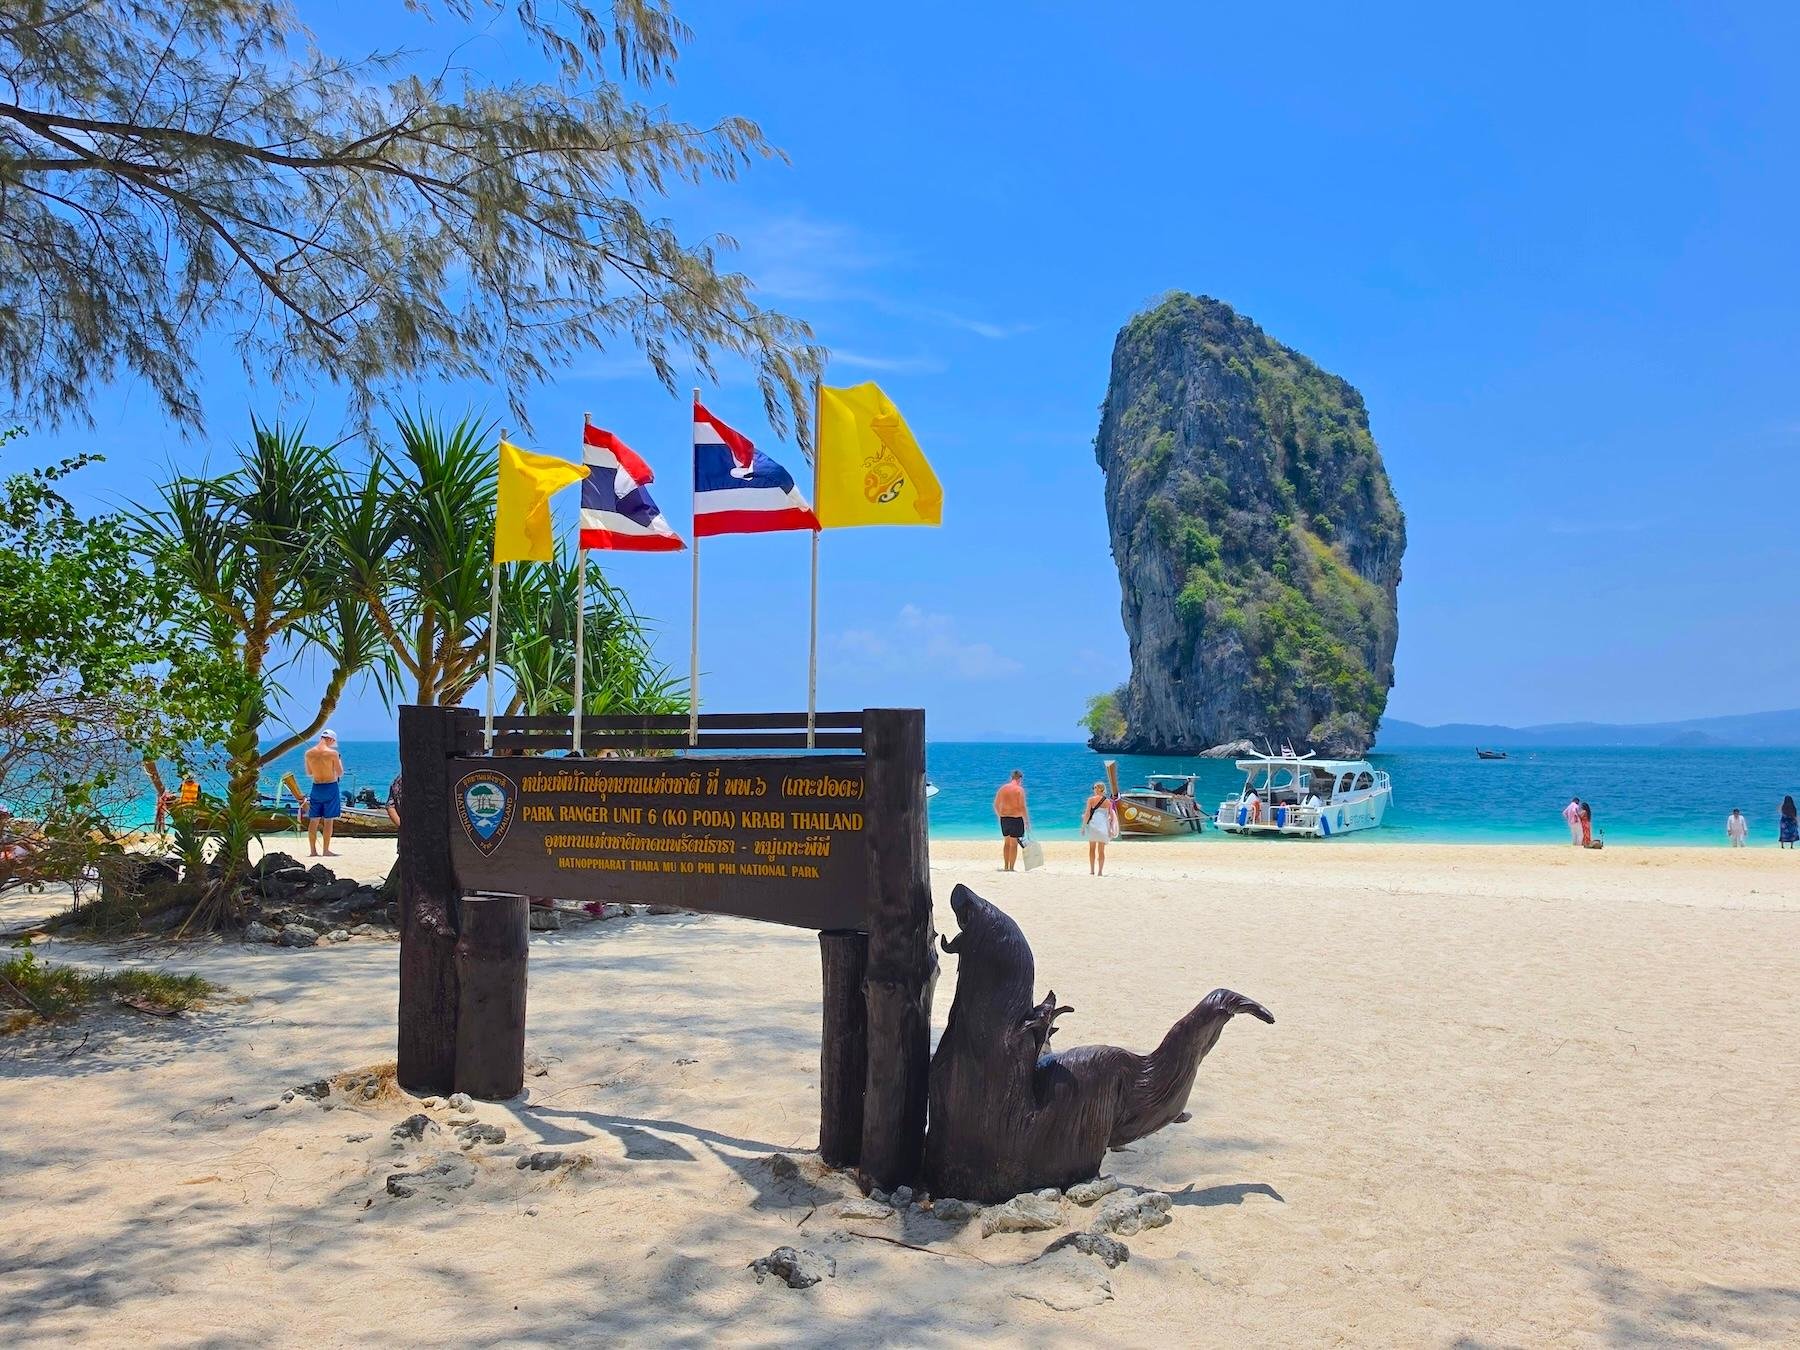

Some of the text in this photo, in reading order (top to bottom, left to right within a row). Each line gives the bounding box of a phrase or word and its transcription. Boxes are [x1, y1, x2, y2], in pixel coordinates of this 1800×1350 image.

[706, 768, 720, 796] ที่
[781, 775, 864, 800] (เกาะปอดะ)
[456, 793, 474, 835] NATIONAL
[496, 797, 513, 836] THAILAND
[522, 806, 863, 831] PARK RANGER UNIT 6 (KO PODA) KRABI THAILAND
[754, 835, 831, 862] หมู่เกาะพีพี
[559, 857, 819, 878] HATNOPPHARAT THARA MU KO PHI PHI NATIONAL PARK
